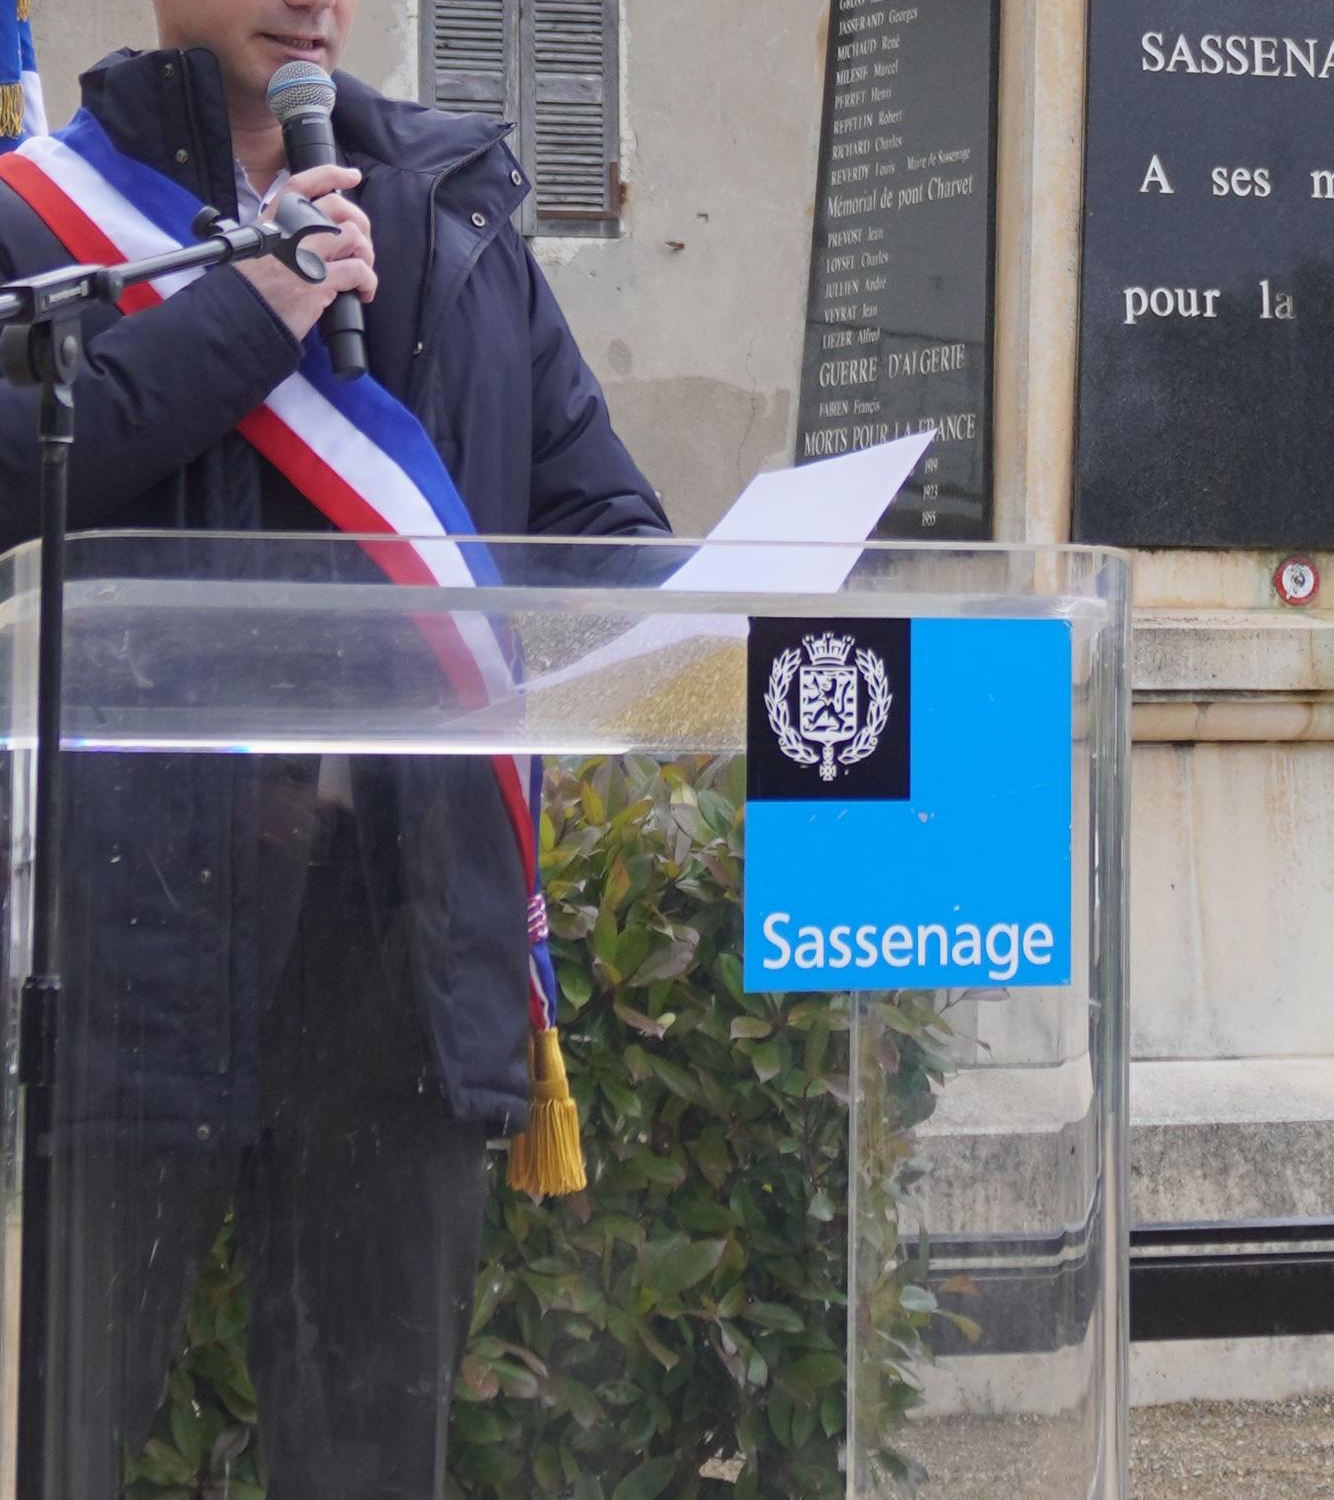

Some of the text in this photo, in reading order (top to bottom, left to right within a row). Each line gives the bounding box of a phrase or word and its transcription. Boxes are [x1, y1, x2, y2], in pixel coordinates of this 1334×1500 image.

[838, 8, 918, 36] JASSERAND Georges
[837, 34, 900, 61] MICHAUD René
[873, 59, 899, 76] Marcel
[834, 85, 892, 110] PERRET Henri
[833, 109, 902, 135] REPELLIN Robert
[832, 134, 902, 161] RICHARD Charles
[830, 163, 871, 186] REVERDY
[875, 162, 895, 177] Louis
[927, 152, 937, 167] de
[1139, 154, 1175, 194] A
[1211, 165, 1272, 198] ses
[827, 174, 973, 219] Mémorial de pont Charvet
[827, 227, 884, 248] PREVOST Jean
[861, 251, 889, 268] Charles
[825, 279, 859, 299] JULLIEN
[1123, 285, 1221, 325] pour
[1259, 279, 1295, 320] la
[823, 303, 878, 324] VEYRAT Jean
[858, 327, 881, 344] Alfred
[819, 343, 965, 387] GUERRE D'ALGERIE
[819, 400, 849, 418] FABIEN
[803, 428, 848, 457] MORTS
[852, 423, 888, 450] POUR
[762, 912, 1054, 980] Sassenage
